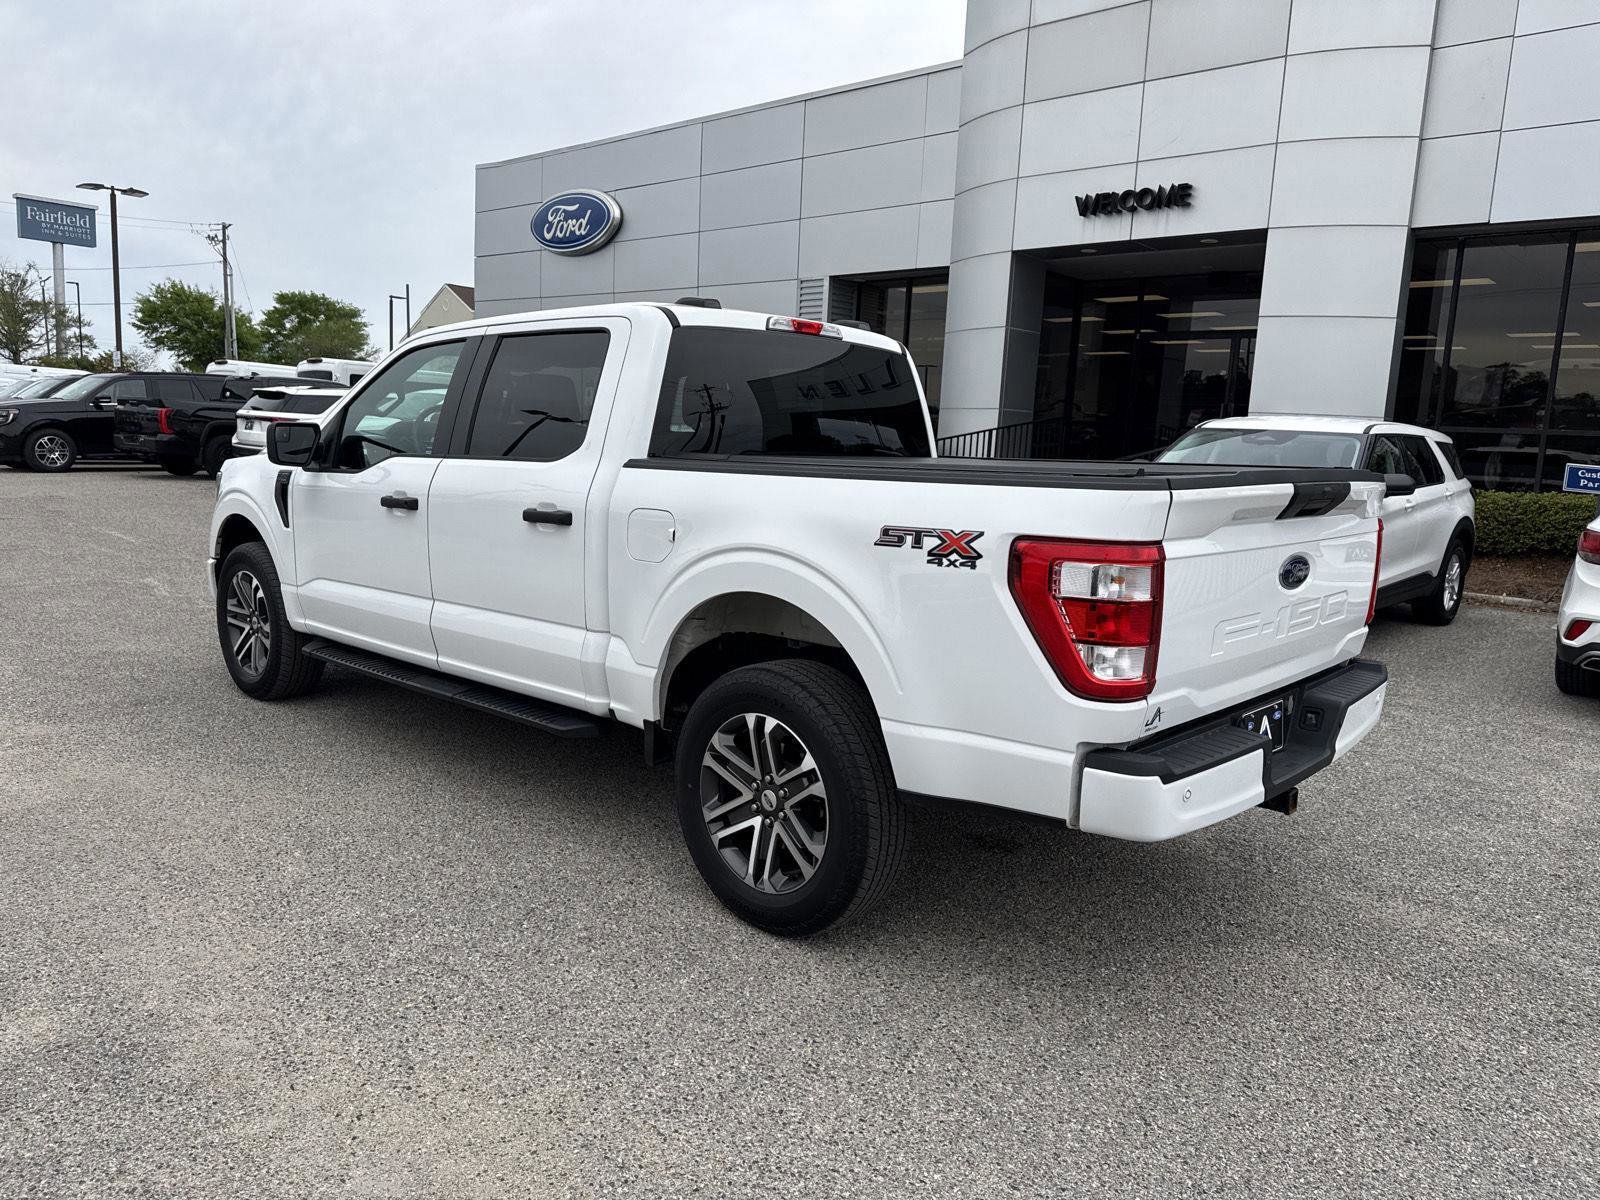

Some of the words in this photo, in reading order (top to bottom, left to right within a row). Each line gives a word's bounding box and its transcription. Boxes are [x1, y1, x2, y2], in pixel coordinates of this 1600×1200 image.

[26, 205, 90, 229] Fairfield
[1074, 182, 1193, 218] WELCOME
[53, 224, 90, 235] MARRIOTT
[65, 231, 91, 240] SUITES
[543, 203, 592, 241] Ford
[874, 524, 985, 561] STX
[1210, 589, 1349, 658] F-150
